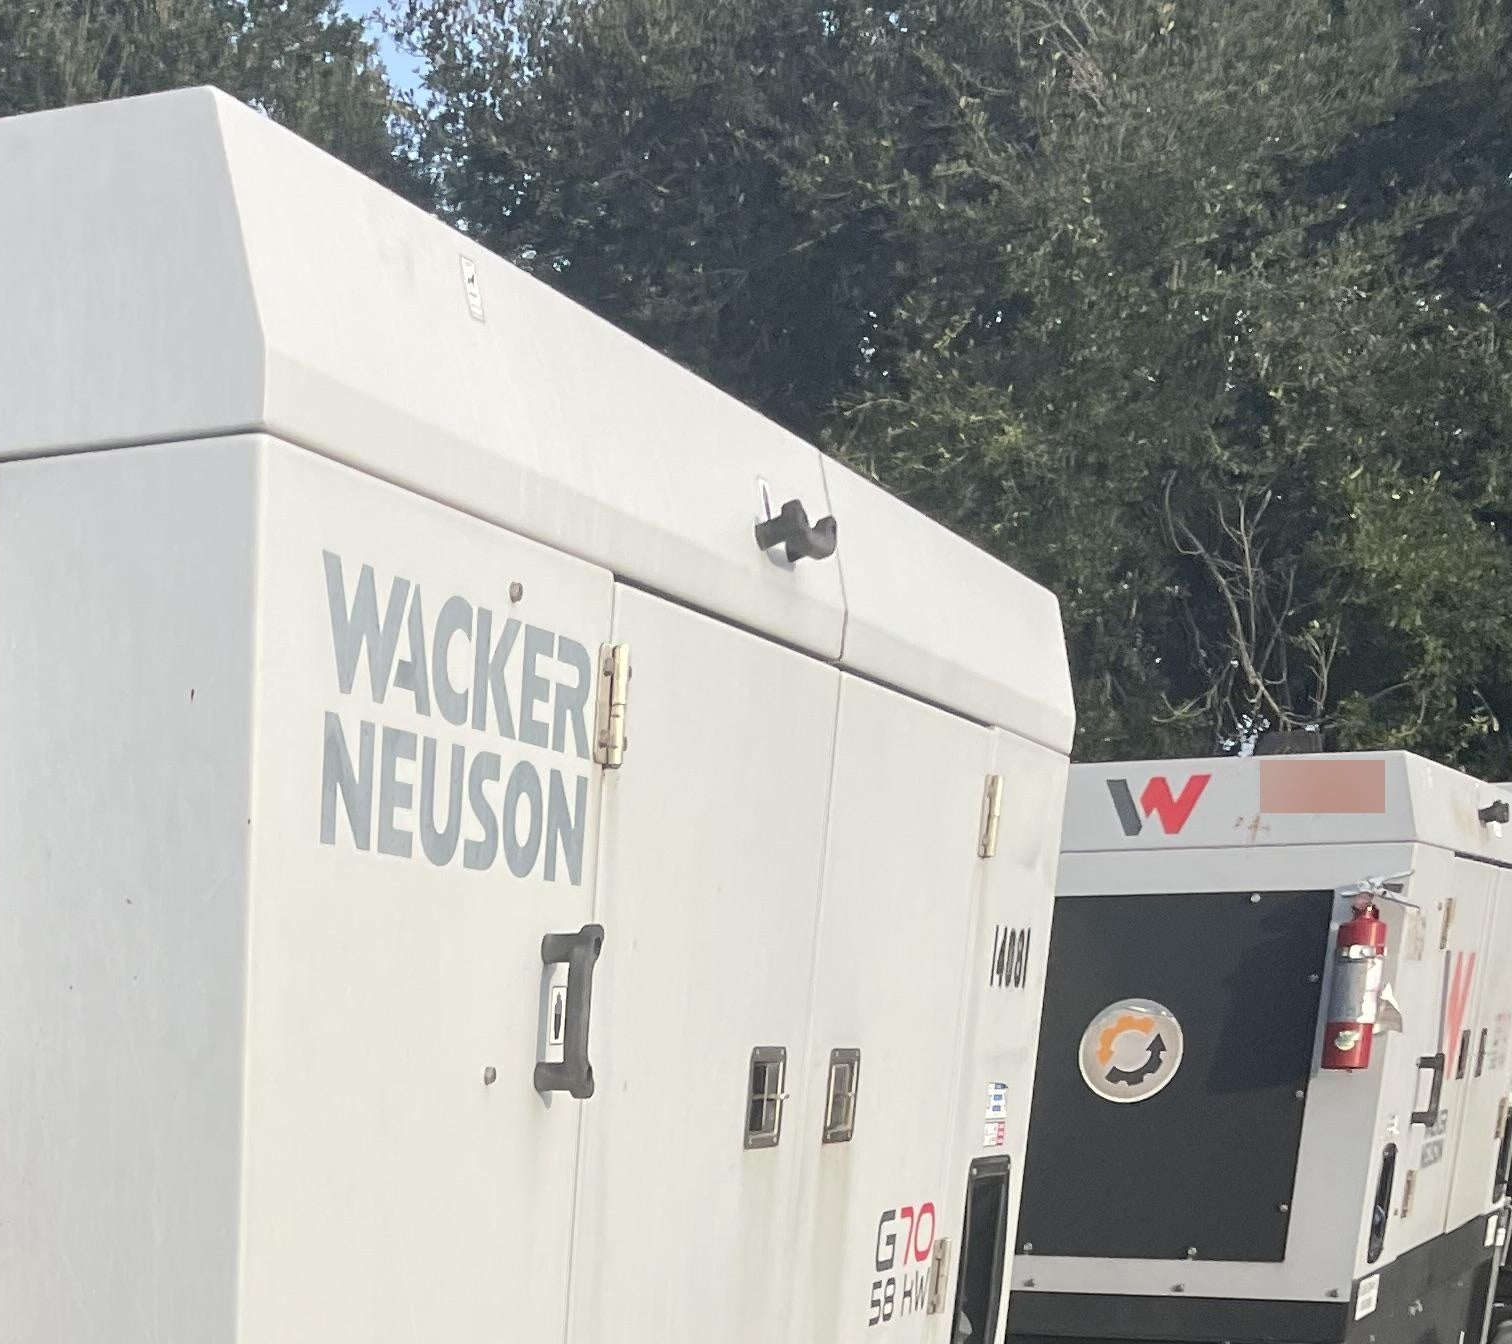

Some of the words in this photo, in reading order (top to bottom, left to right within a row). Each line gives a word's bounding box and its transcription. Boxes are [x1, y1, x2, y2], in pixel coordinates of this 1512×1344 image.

[322, 548, 592, 761] WACKER
[319, 709, 589, 887] NEUSON
[989, 924, 1031, 989] 14081
[875, 1201, 936, 1273] G70
[868, 1276, 897, 1327] 58
